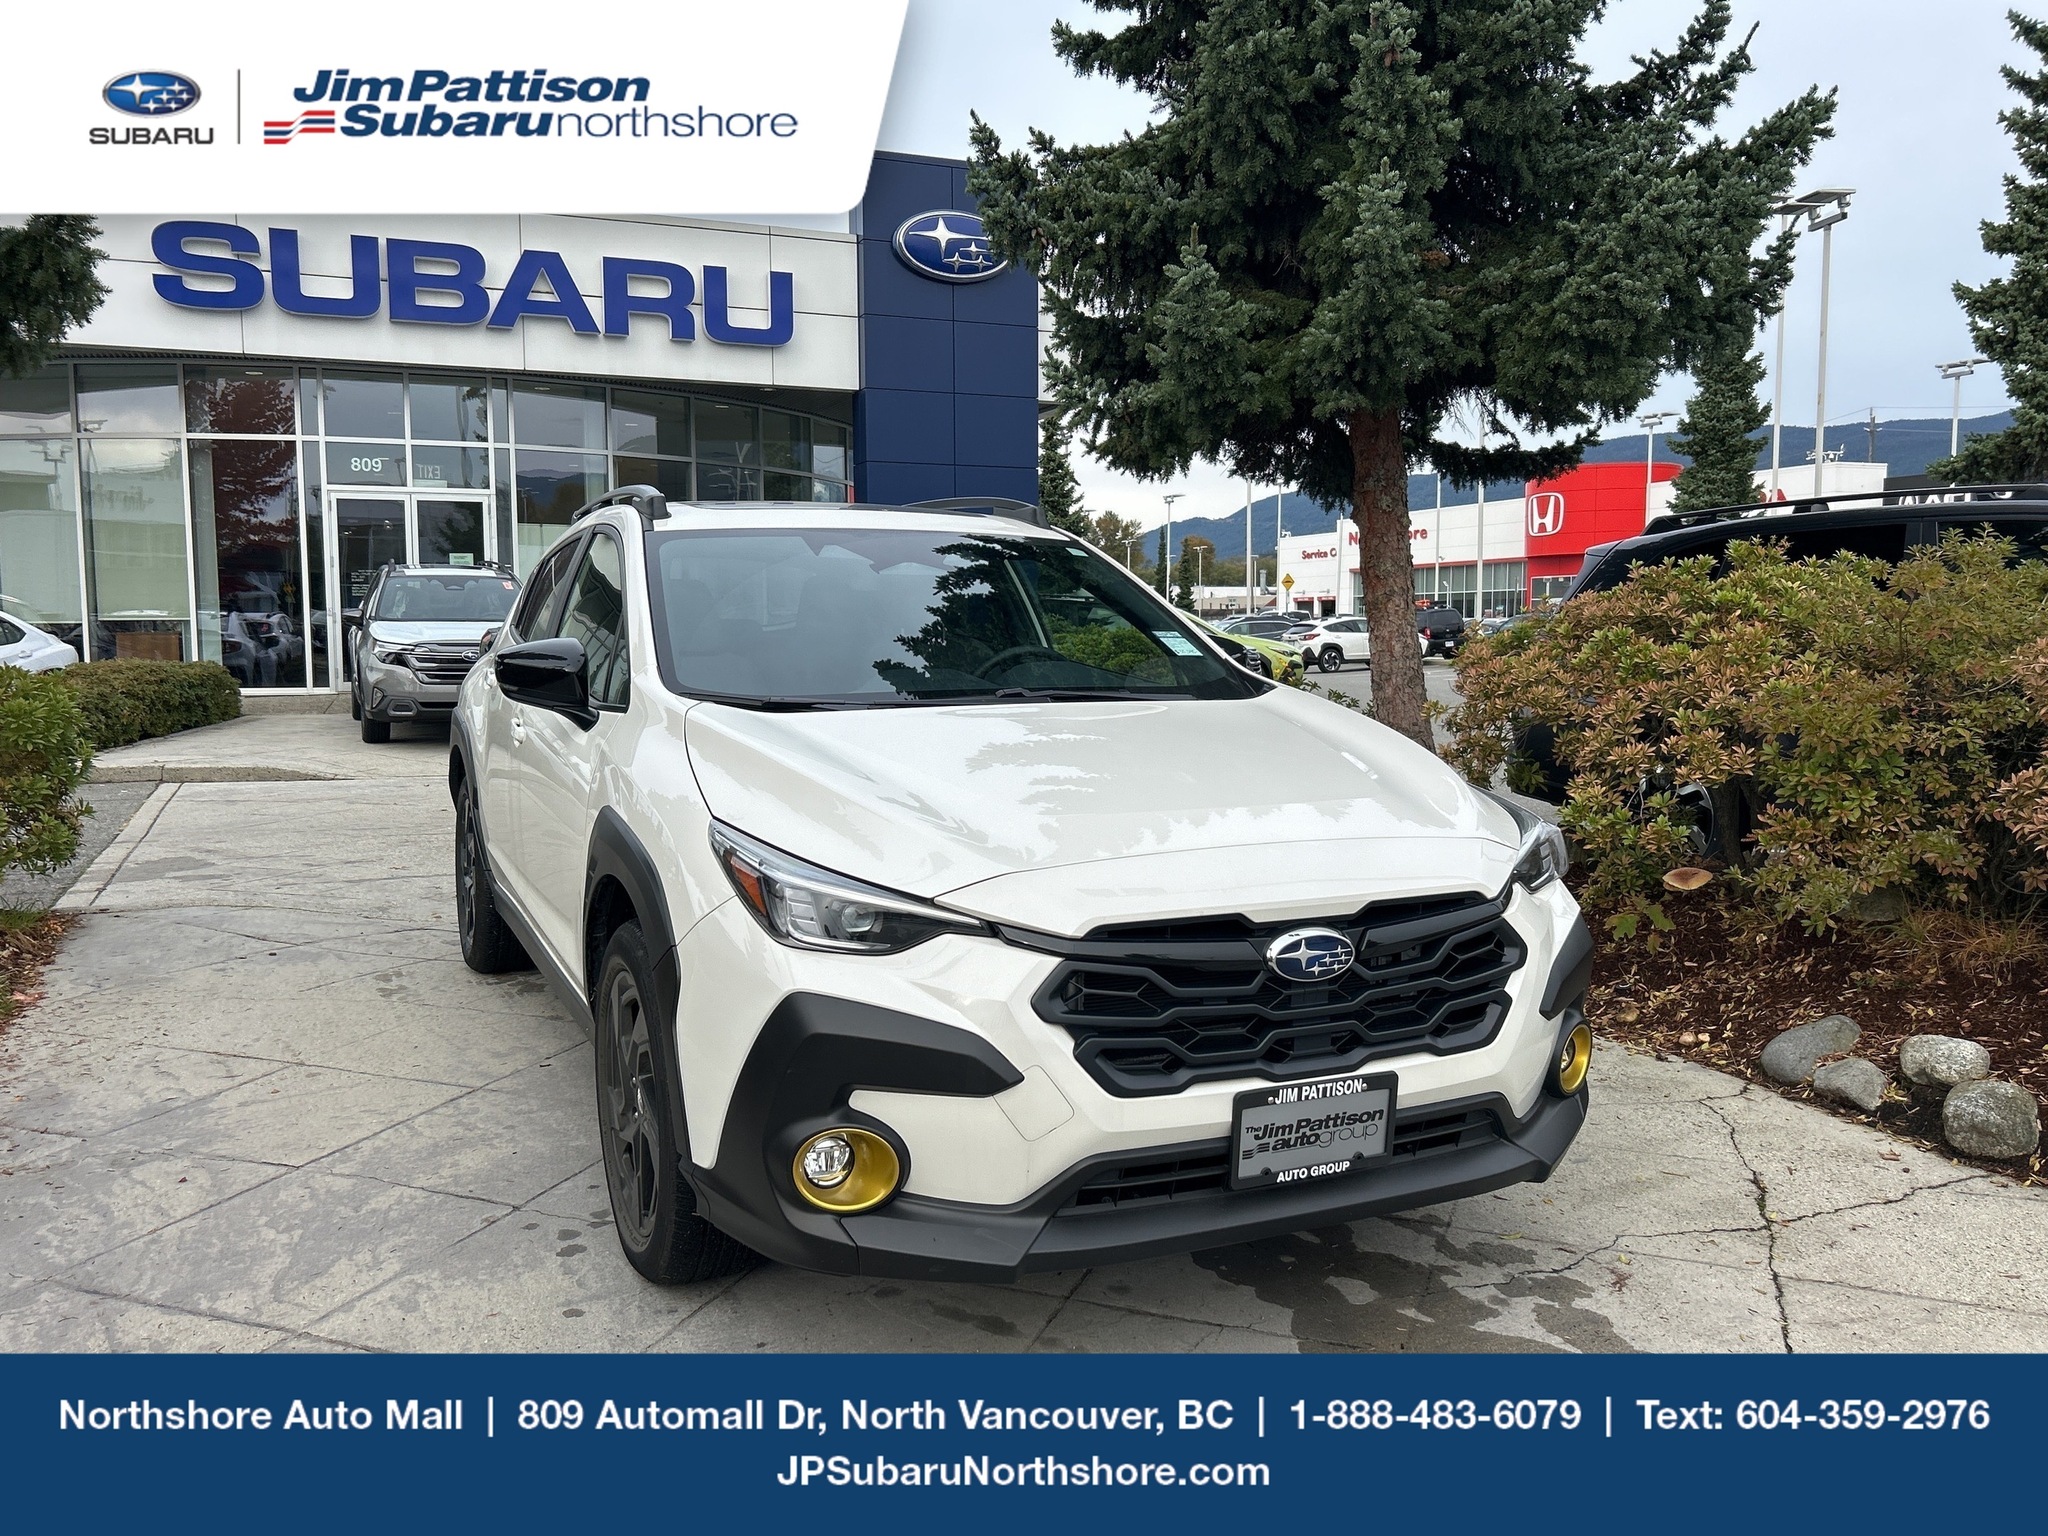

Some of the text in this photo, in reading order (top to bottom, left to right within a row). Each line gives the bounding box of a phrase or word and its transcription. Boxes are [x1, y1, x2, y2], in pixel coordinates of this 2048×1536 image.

[151, 219, 795, 349] SUBARU
[350, 457, 382, 473] 809
[1301, 548, 1329, 560] Service
[1274, 1078, 1363, 1105] JIM PATTISON
[1245, 1108, 1385, 1141] The Jim Pattison
[1271, 1123, 1379, 1152] auto group
[1276, 1160, 1351, 1184] AUTO GROUP
